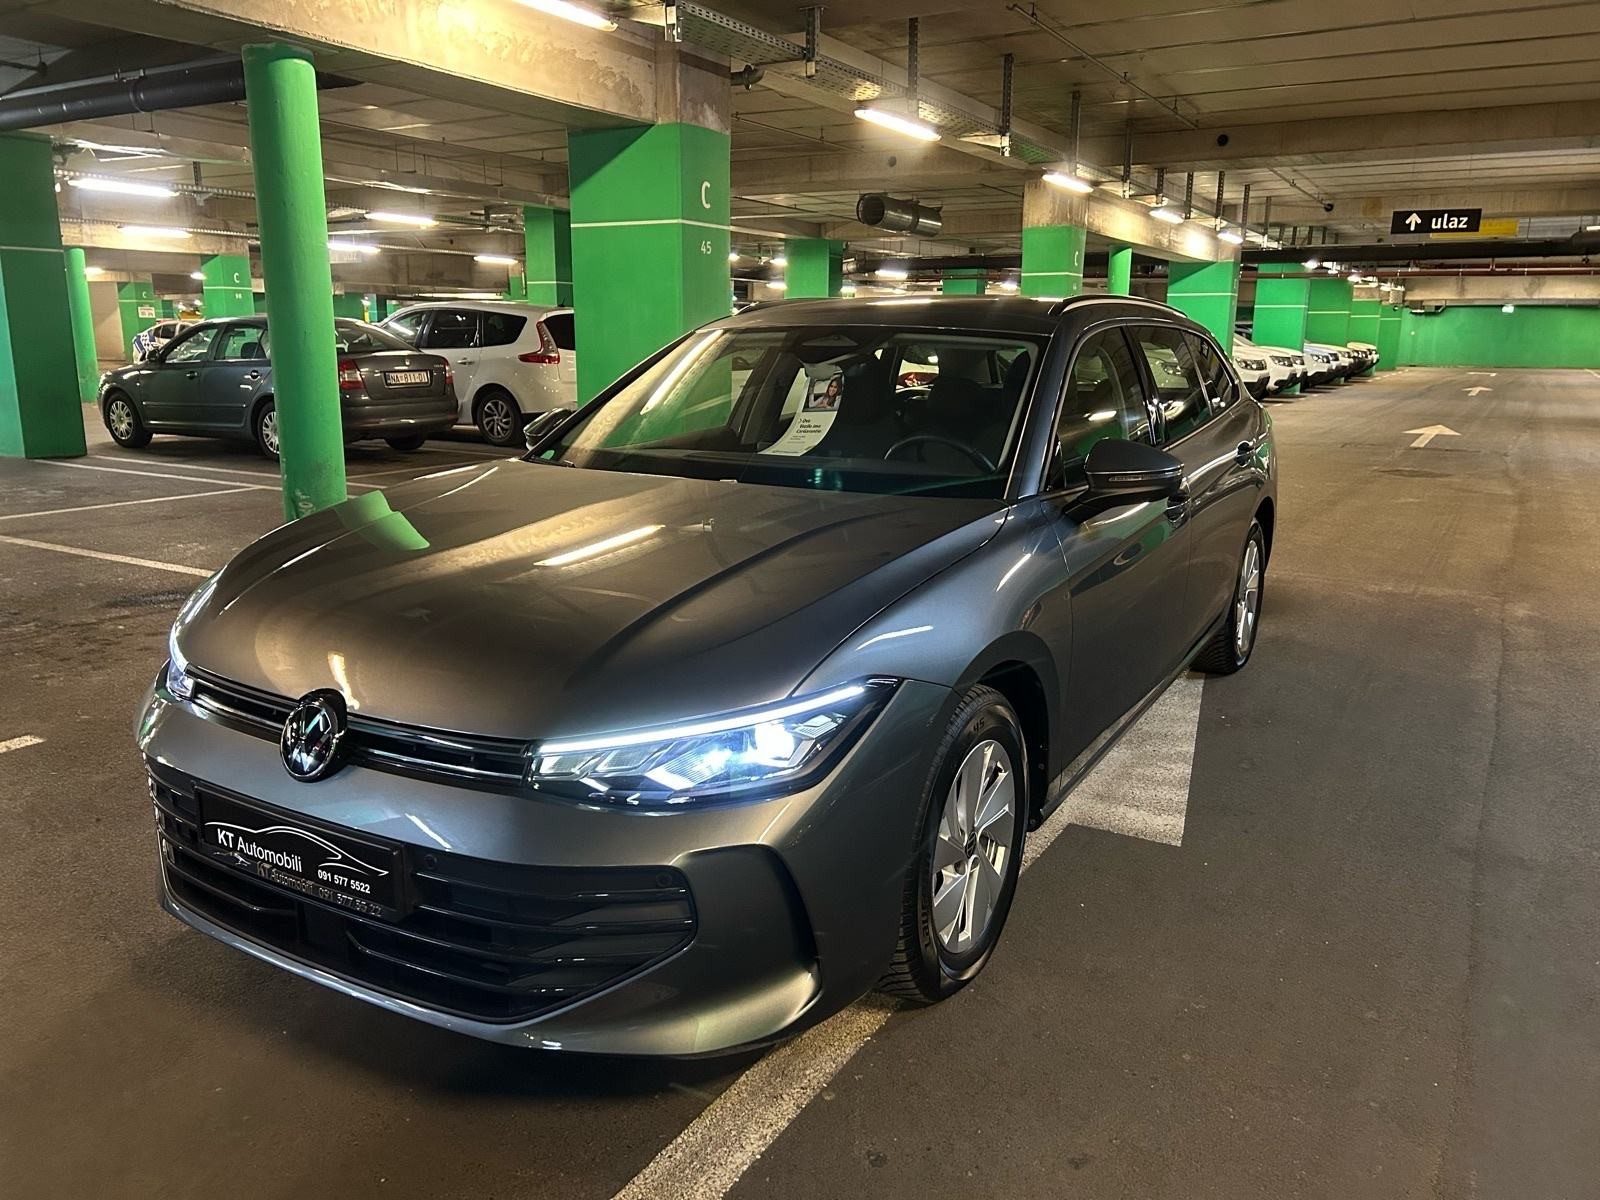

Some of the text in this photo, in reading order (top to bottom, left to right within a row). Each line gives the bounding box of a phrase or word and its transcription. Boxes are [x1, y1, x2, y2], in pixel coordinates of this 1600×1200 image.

[701, 180, 711, 209] C
[1431, 213, 1469, 229] ulaz
[700, 240, 712, 254] 45
[233, 272, 240, 283] C
[217, 828, 303, 873] KT Automobili
[256, 860, 272, 877] KT
[317, 869, 371, 894] 091 577 5522
